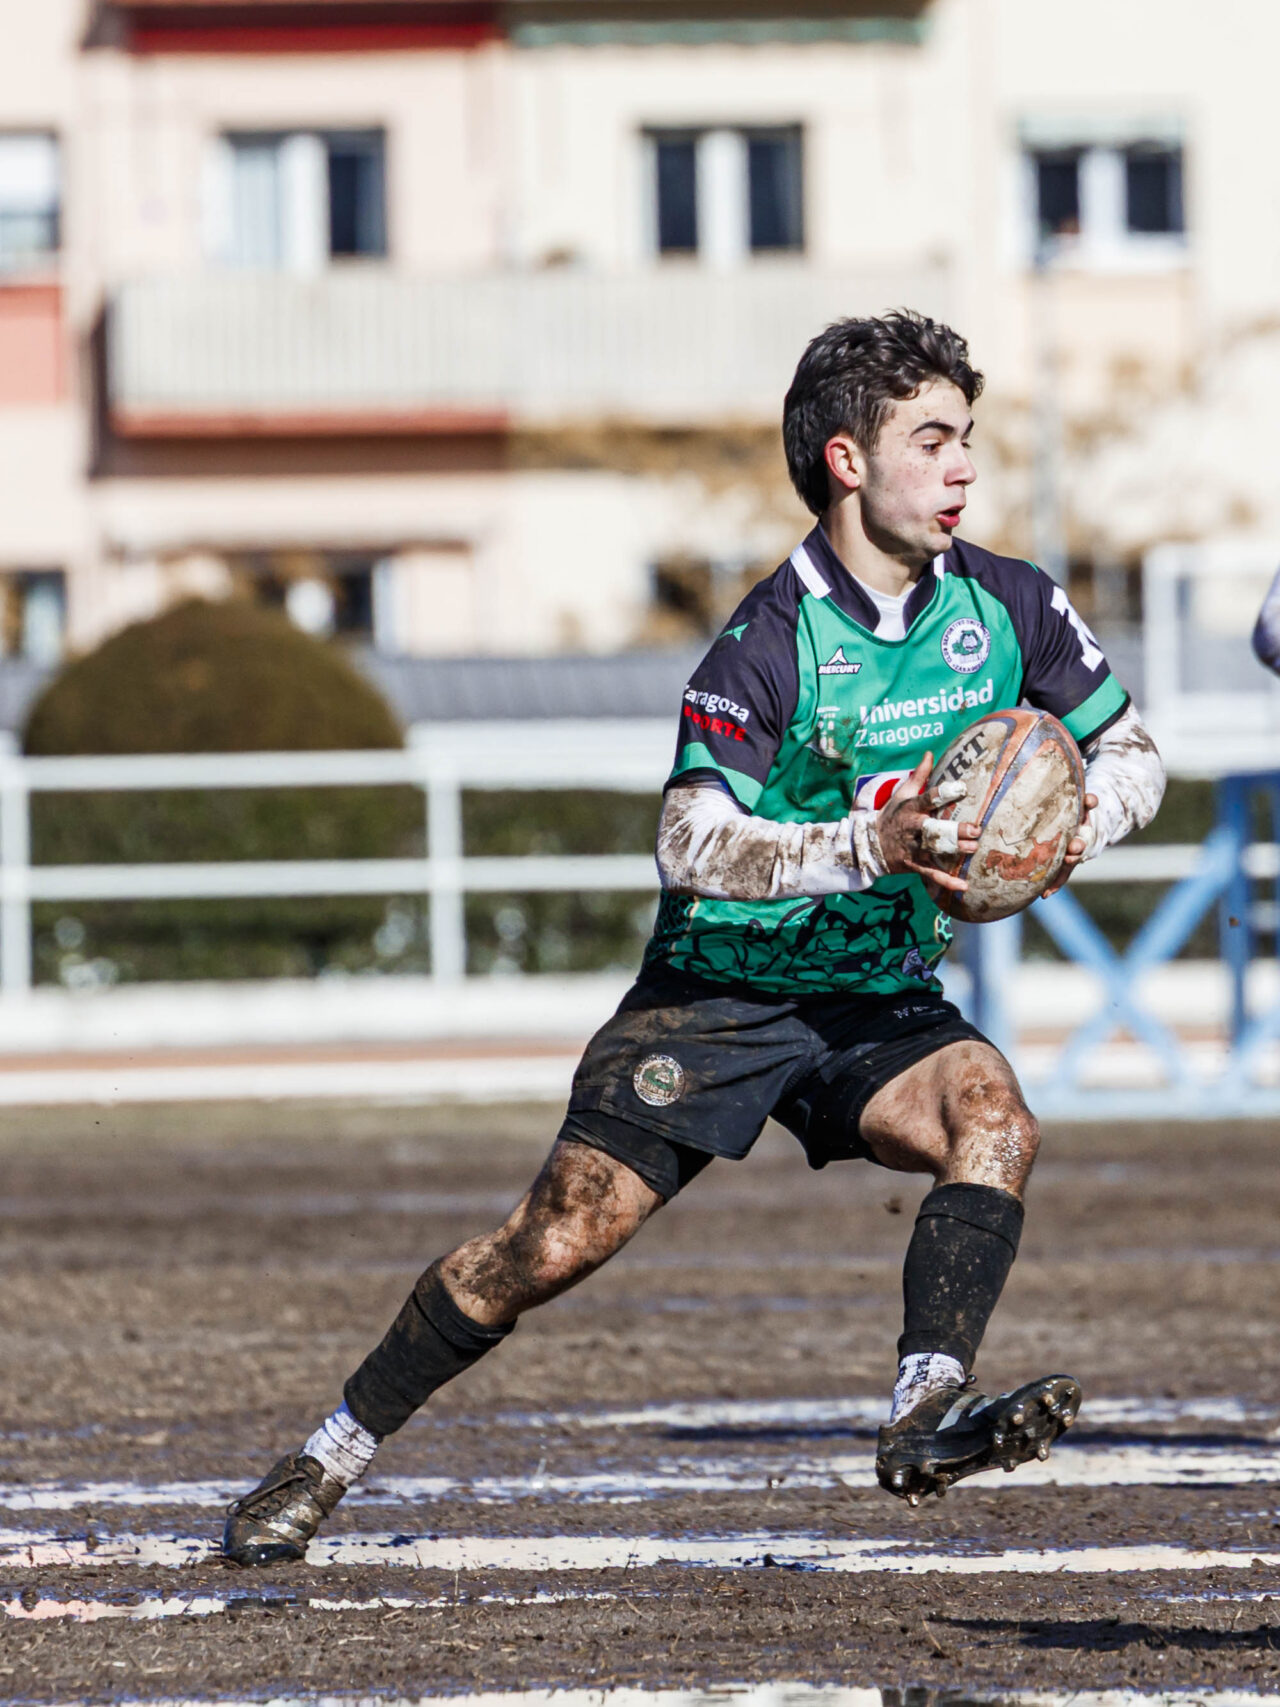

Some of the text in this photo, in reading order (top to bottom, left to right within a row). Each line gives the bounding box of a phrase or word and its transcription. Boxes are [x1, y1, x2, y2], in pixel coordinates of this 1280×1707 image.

[684, 684, 750, 724] aragoza
[860, 678, 994, 725] Universidad
[854, 721, 945, 748] Zaragoza
